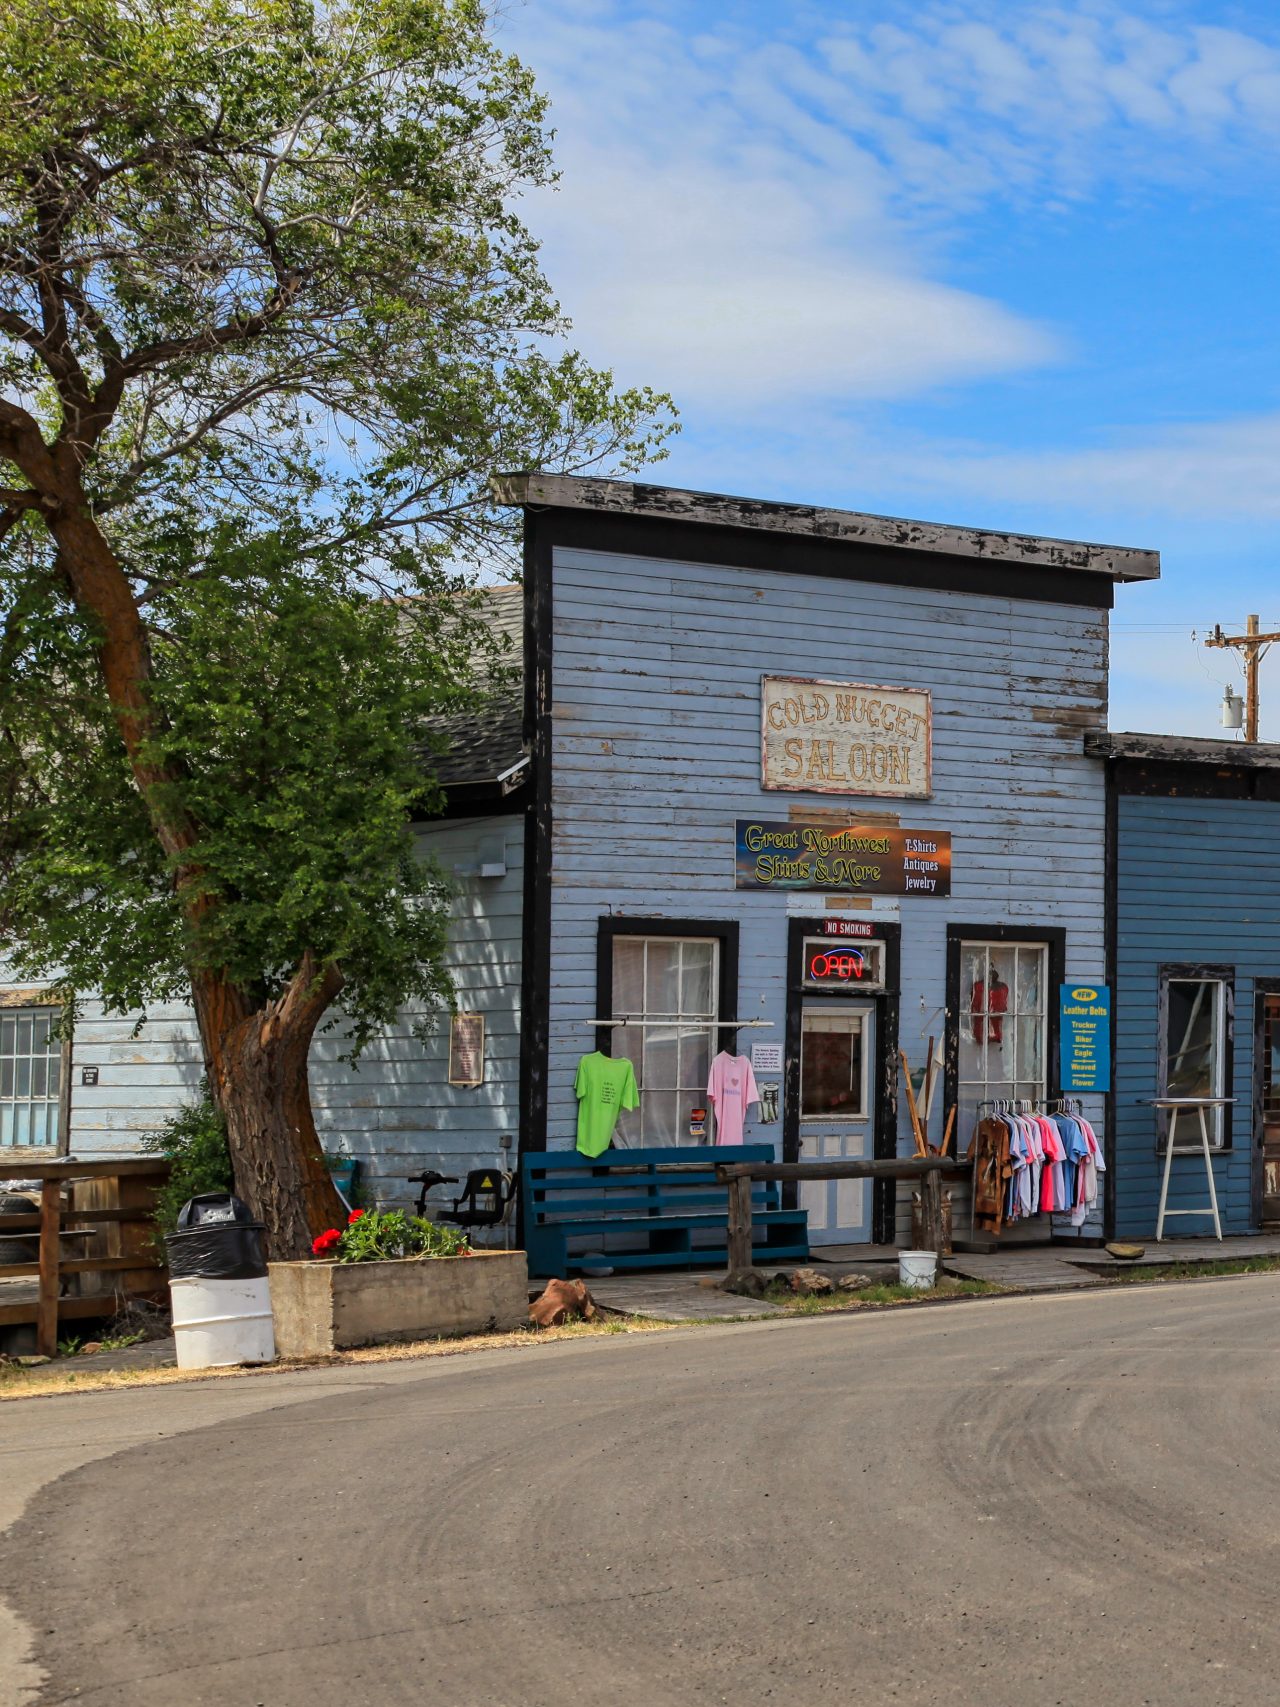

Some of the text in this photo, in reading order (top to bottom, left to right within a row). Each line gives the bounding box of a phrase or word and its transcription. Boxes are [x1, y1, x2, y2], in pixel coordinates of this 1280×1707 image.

[784, 738, 910, 785] SALOON
[745, 825, 890, 856] Great Northwest
[905, 838, 937, 853] T-Shirts
[754, 855, 881, 887] Shirts & More
[903, 857, 939, 873] Antiques
[905, 874, 937, 893] Jewelry
[827, 922, 871, 936] NO SMOKING
[811, 953, 864, 978] OPEN
[1076, 990, 1093, 999] NEW
[1063, 1004, 1107, 1017] Leather Belts
[1075, 1035, 1093, 1043] Biker
[1074, 1049, 1093, 1058] Eagle
[1072, 1079, 1095, 1087] Flower
